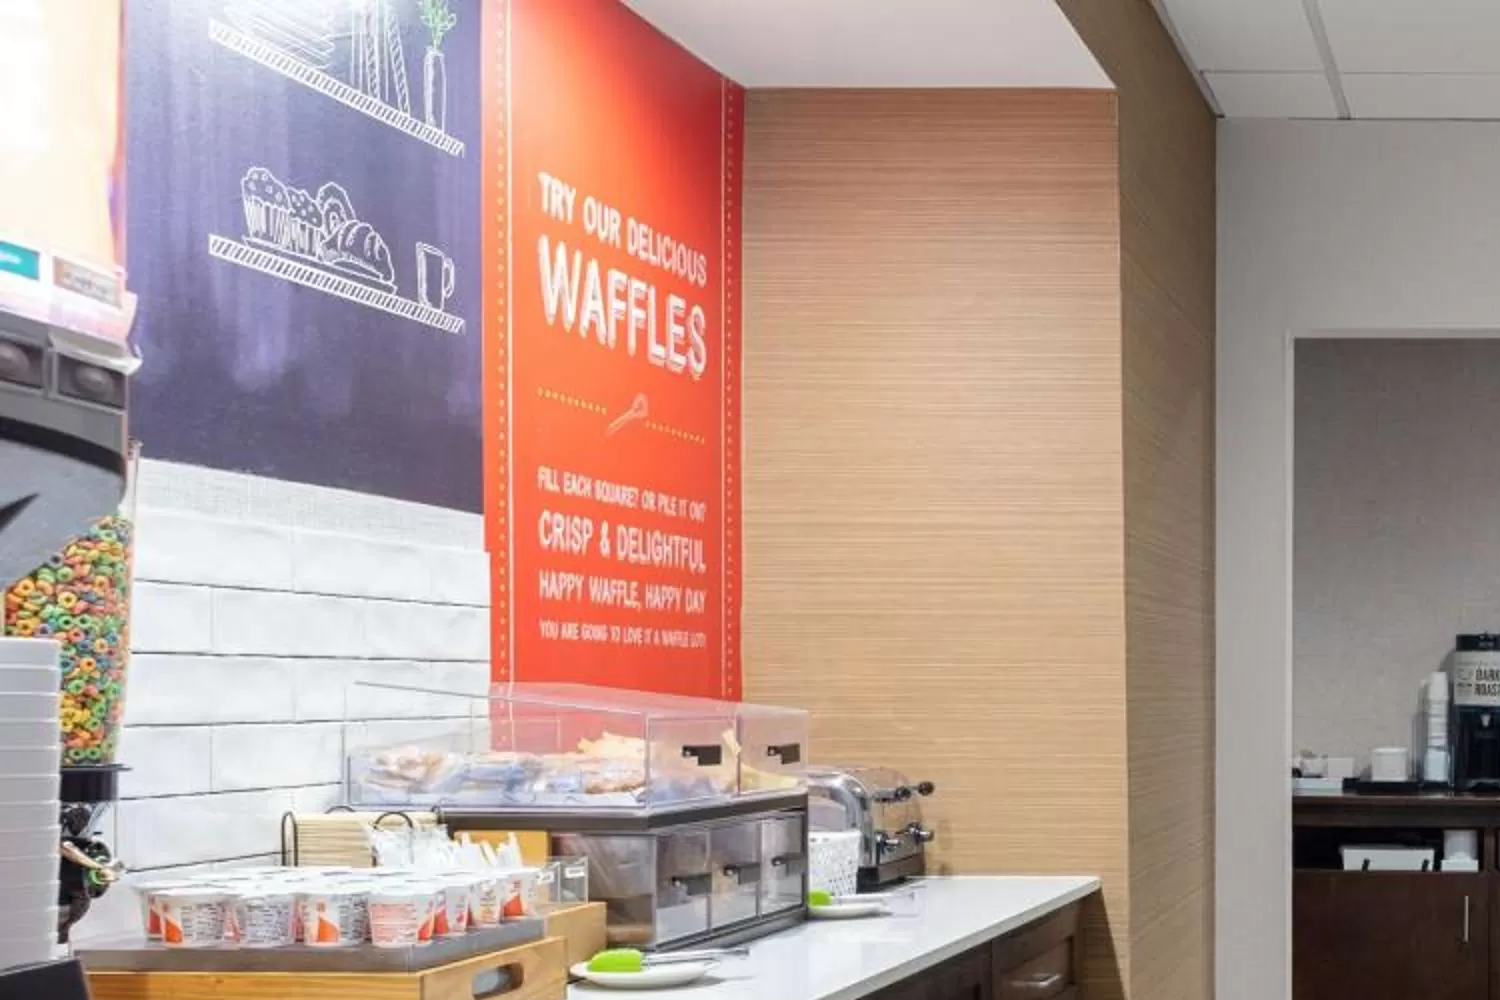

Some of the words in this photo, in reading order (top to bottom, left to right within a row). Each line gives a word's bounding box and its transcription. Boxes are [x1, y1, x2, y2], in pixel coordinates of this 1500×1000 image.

[538, 172, 576, 224] TRY
[583, 195, 621, 248] OUR
[627, 216, 707, 287] DELICIOUS
[538, 234, 707, 380] WAFFLES
[538, 465, 560, 493] FILL
[563, 472, 592, 497] EACH
[642, 490, 656, 512] OR
[658, 492, 676, 516] PILE
[679, 499, 688, 517] IT
[538, 509, 593, 555] CRISP
[600, 521, 610, 558] &
[616, 525, 706, 574] DELIGHTFUL
[539, 570, 584, 602] HAPPY
[589, 575, 641, 611] WAFFLE,
[645, 584, 682, 612] HAPPY
[685, 588, 706, 613] DAY
[540, 619, 558, 639] YOU
[561, 622, 579, 641] ARE
[582, 624, 608, 642] GOING
[623, 626, 643, 645] LOVE
